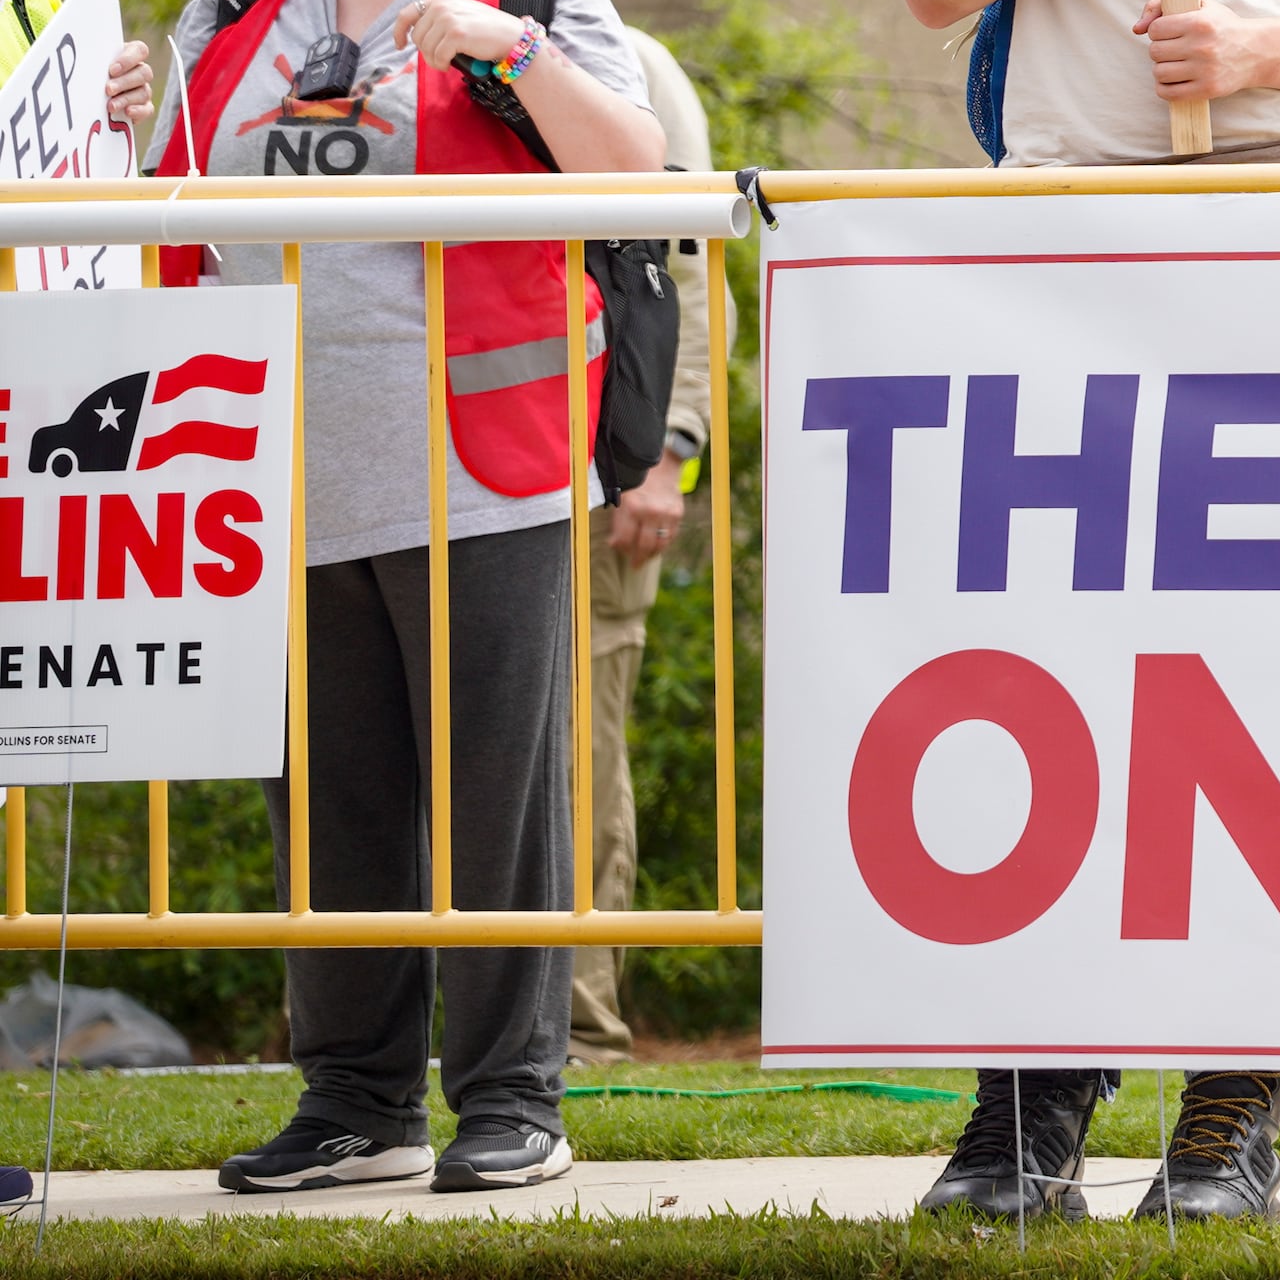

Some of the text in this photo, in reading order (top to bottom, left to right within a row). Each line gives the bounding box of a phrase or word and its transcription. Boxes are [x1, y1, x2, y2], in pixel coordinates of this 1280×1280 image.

[0, 32, 77, 179] EEP
[263, 129, 370, 176] NO
[33, 735, 55, 746] FOR
[57, 734, 97, 745] SENATE
